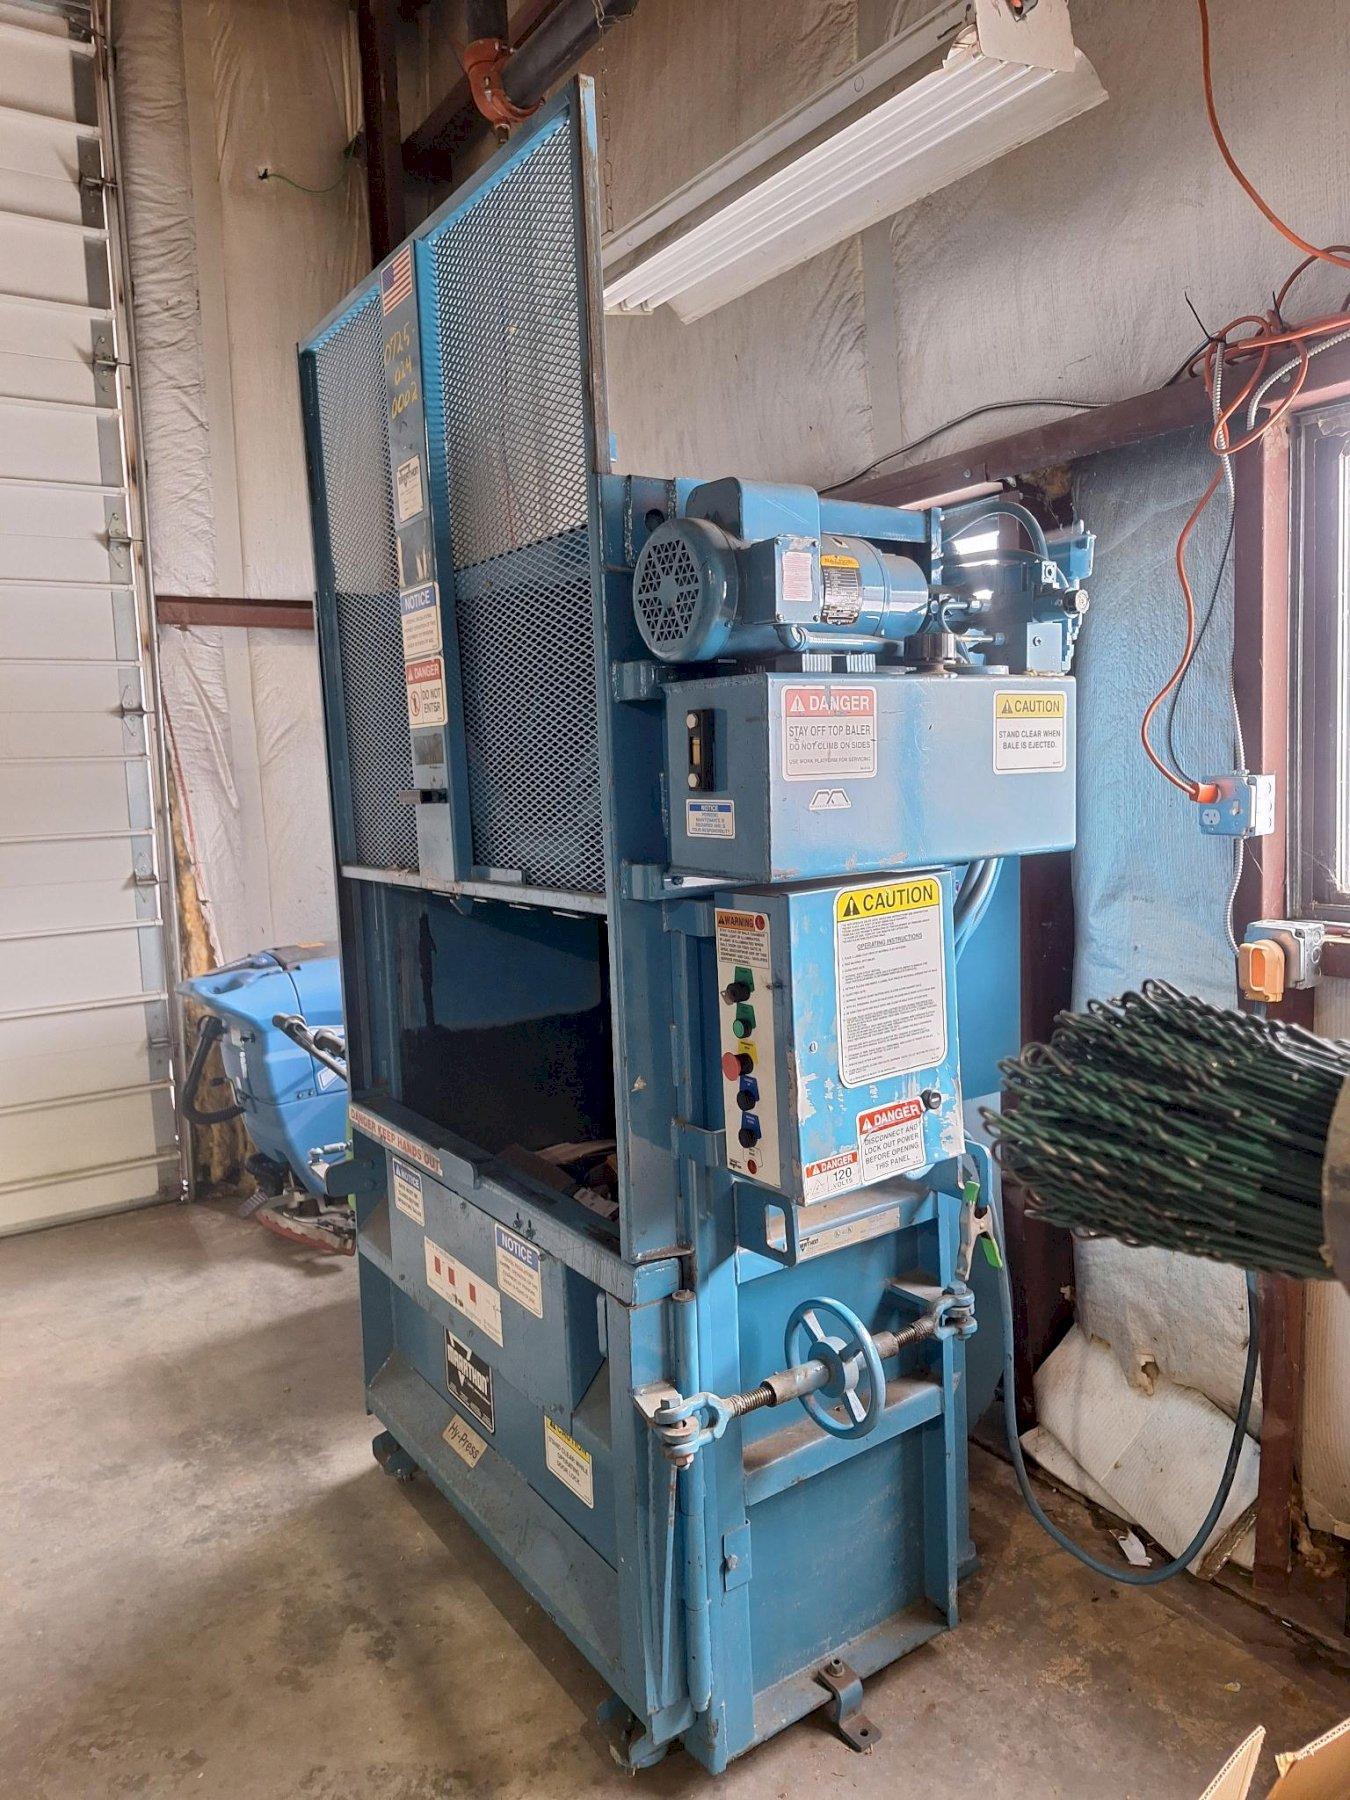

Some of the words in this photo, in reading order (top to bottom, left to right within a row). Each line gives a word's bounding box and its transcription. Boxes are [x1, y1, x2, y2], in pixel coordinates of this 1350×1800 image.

[404, 590, 431, 611] NOTICE
[414, 663, 440, 680] DANGER
[422, 689, 430, 700] DO
[430, 687, 441, 699] NOT
[424, 703, 441, 714] ENTER
[809, 695, 870, 711] DANGER
[1014, 700, 1060, 713] CAUTION
[789, 725, 808, 737] STAY
[810, 725, 826, 736] OFF
[828, 725, 843, 736] TOP
[845, 724, 871, 736] BALER
[999, 730, 1020, 739] STAND
[1021, 730, 1041, 738] CLEAR
[789, 742, 799, 751] DO
[801, 742, 815, 750] NOT
[817, 742, 838, 750] CLIMB
[840, 741, 850, 749] ON
[851, 741, 871, 749] SIDES
[1002, 742, 1020, 750] BALE
[1021, 741, 1027, 749] IS
[863, 884, 933, 911] CAUTION
[724, 915, 754, 928] WARNING
[857, 939, 886, 951] OPERATING
[887, 932, 923, 945] INSTRUCTIONS
[874, 1104, 920, 1125] DANGER
[351, 1108, 376, 1133] DANGER
[377, 1126, 396, 1144] KEEP
[397, 1136, 422, 1160] HANDS
[864, 1128, 905, 1146] DISCONNECT
[905, 1124, 918, 1135] AND
[865, 1145, 882, 1156] LOCK
[883, 1140, 896, 1150] OUT
[896, 1133, 919, 1147] POWER
[865, 1152, 890, 1165] BEFORE
[891, 1142, 919, 1156] OPENING
[821, 1154, 853, 1172] DANGER
[875, 1161, 889, 1171] THIS
[890, 1155, 911, 1167] PANEL
[400, 1169, 420, 1187] NOTICE
[833, 1167, 852, 1182] 120
[501, 1232, 533, 1265] NOTICE
[447, 1344, 488, 1396] MARATHON
[448, 1422, 480, 1459] Hy-Press
